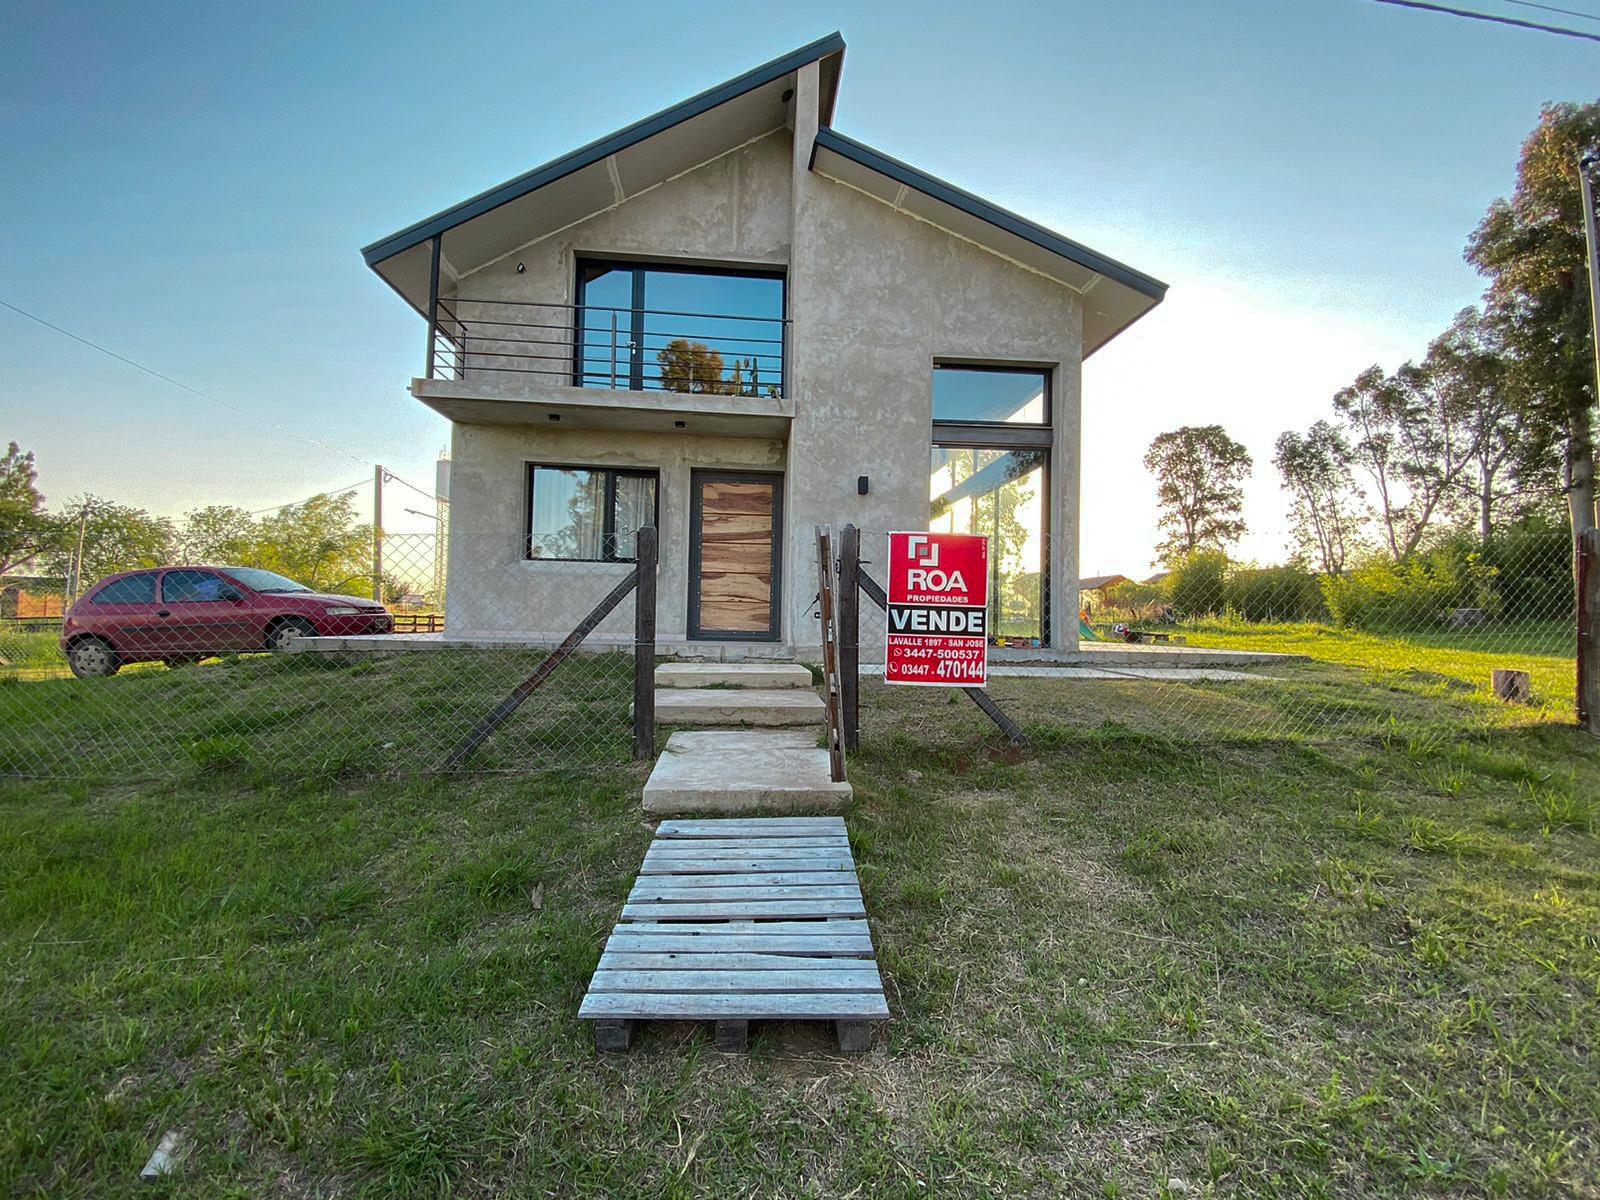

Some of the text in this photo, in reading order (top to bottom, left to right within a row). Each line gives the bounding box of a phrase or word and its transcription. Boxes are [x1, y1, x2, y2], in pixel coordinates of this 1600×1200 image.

[907, 569, 968, 592] ROA
[907, 594, 969, 603] PROPIEDADES
[890, 609, 983, 632] VENDE
[889, 637, 922, 646] LAVALLE
[925, 638, 942, 647] 1897
[948, 639, 963, 648] SAN
[903, 648, 980, 660] 3447-500537
[901, 663, 930, 675] 03447
[936, 660, 983, 679] 470144
